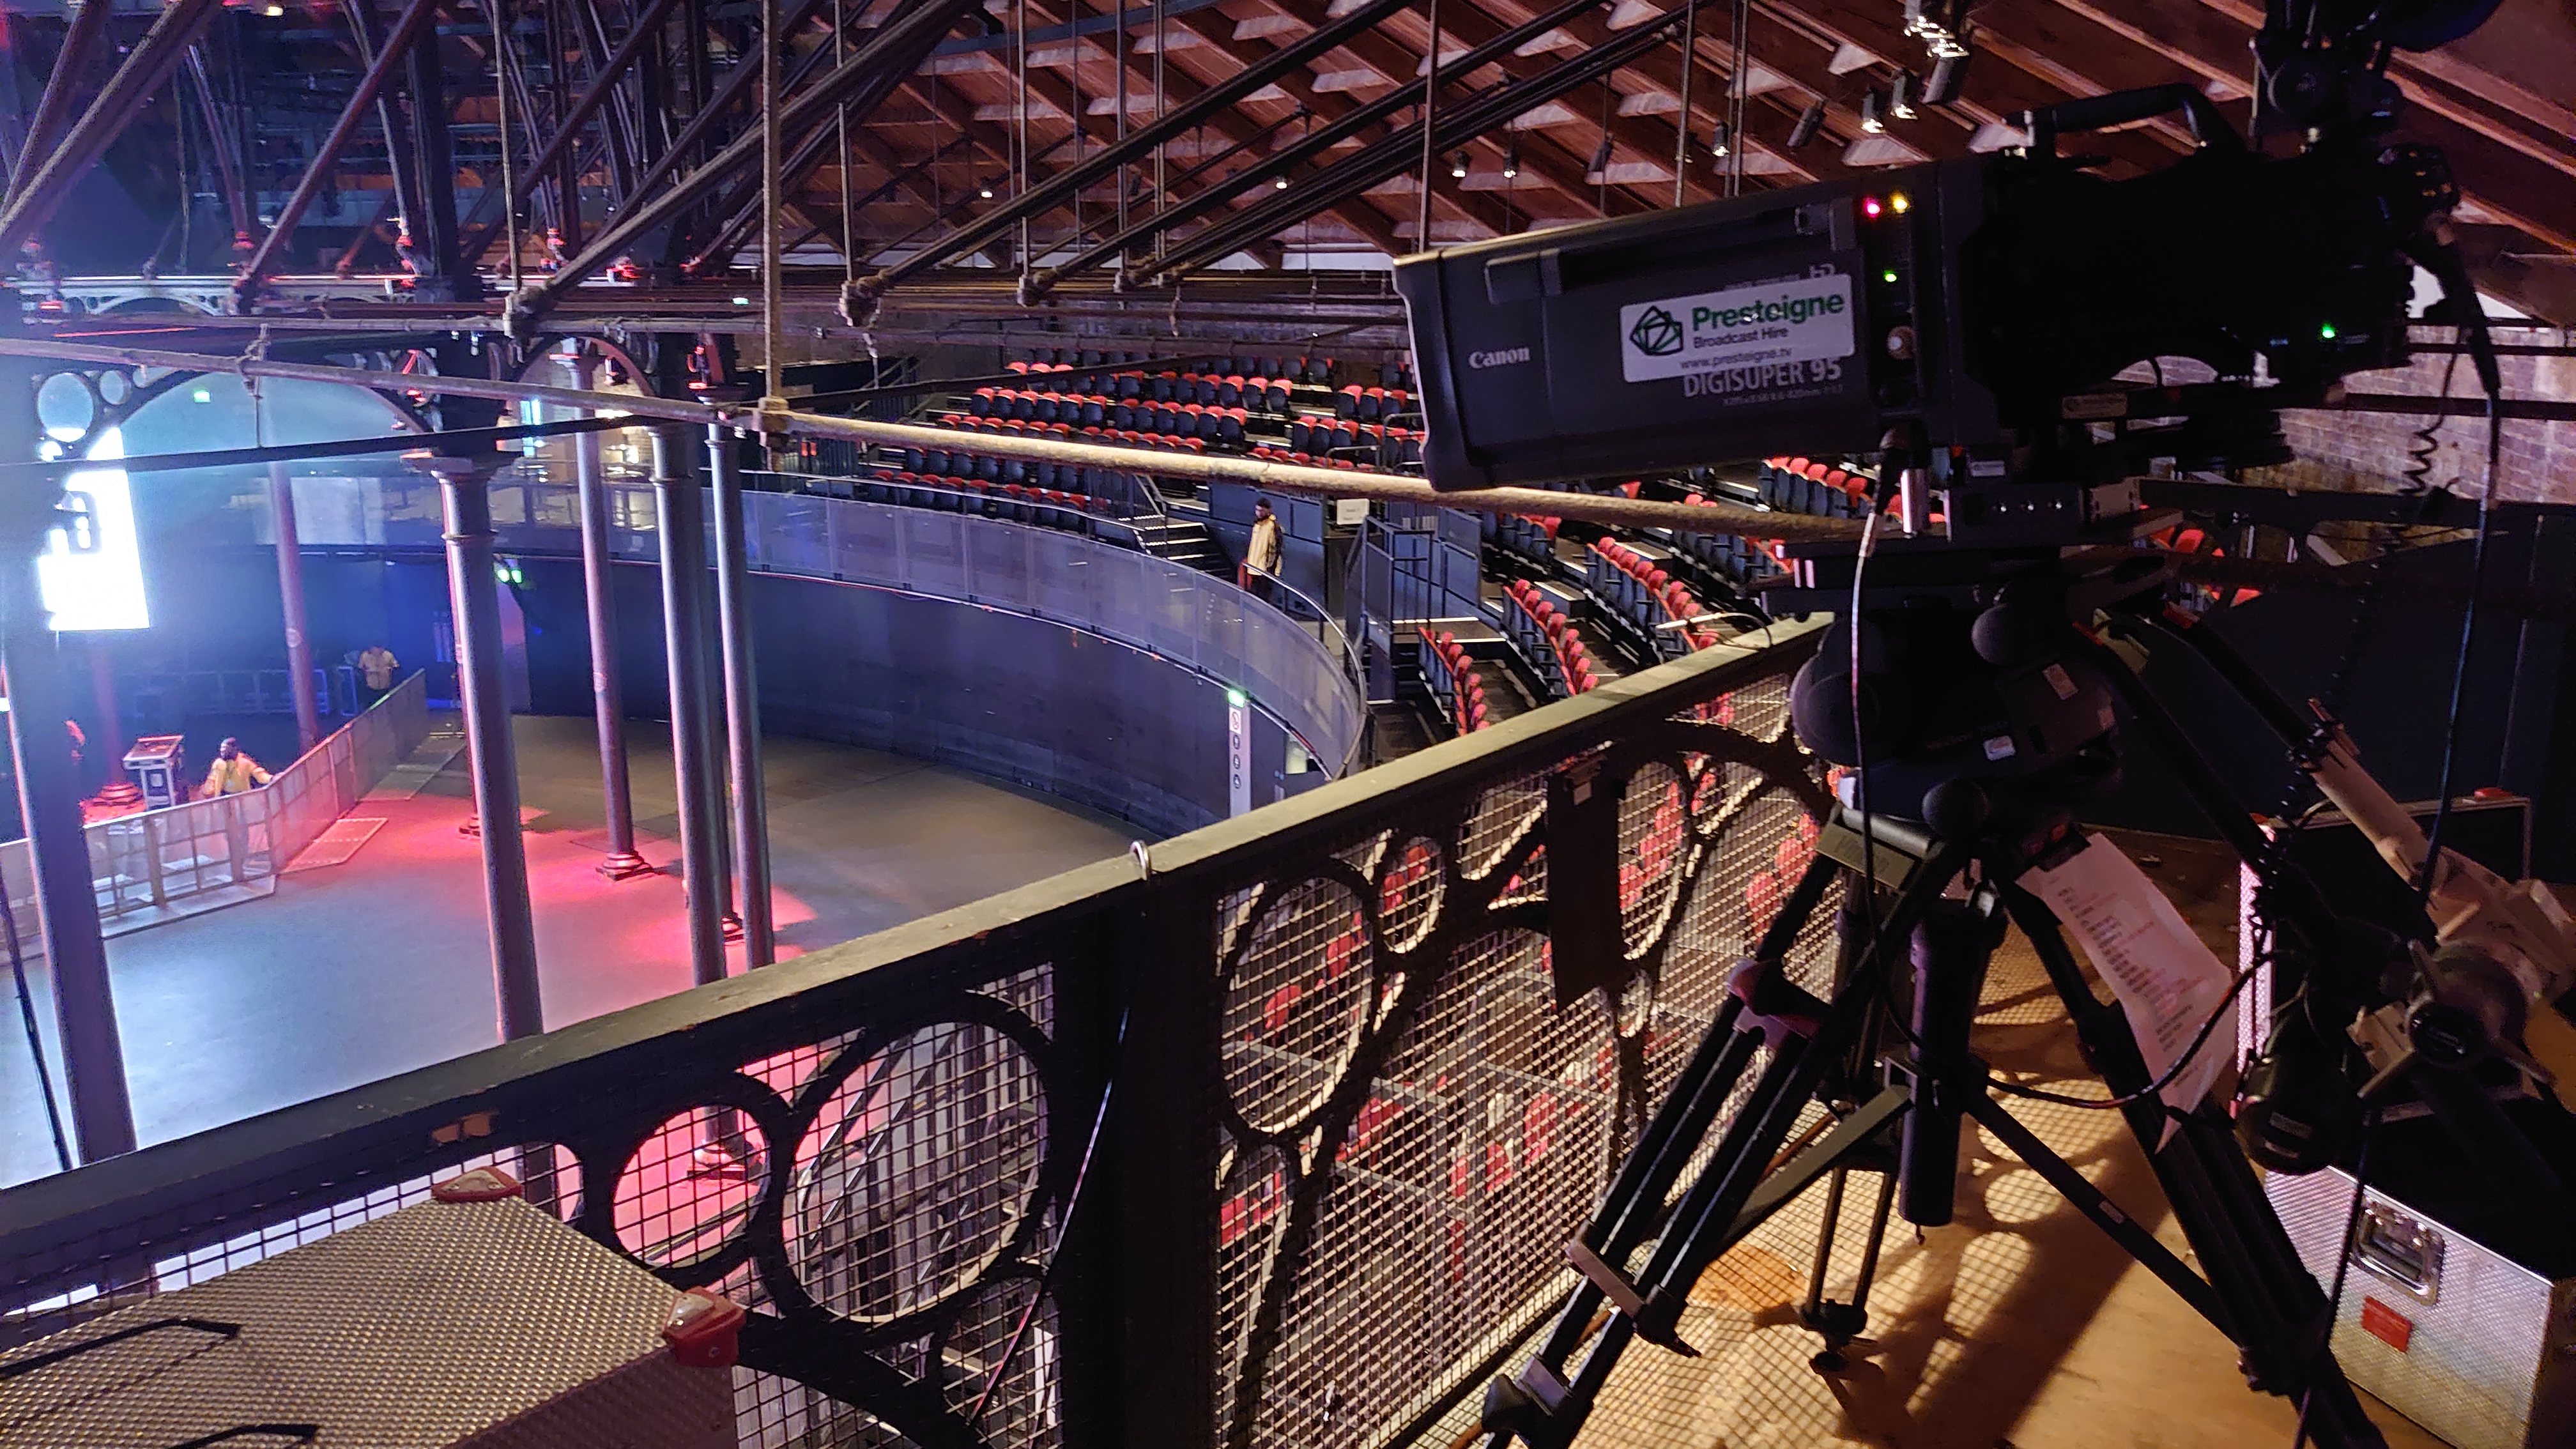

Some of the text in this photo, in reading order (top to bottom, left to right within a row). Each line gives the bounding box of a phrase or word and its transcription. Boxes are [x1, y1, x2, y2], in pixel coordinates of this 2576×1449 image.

[1692, 294, 1844, 331] Presteigne
[1694, 326, 1788, 349] Broadcast Hire
[1469, 348, 1530, 369] Canon
[1683, 361, 1804, 397] DIGISUPER
[1809, 358, 1843, 382] 95
